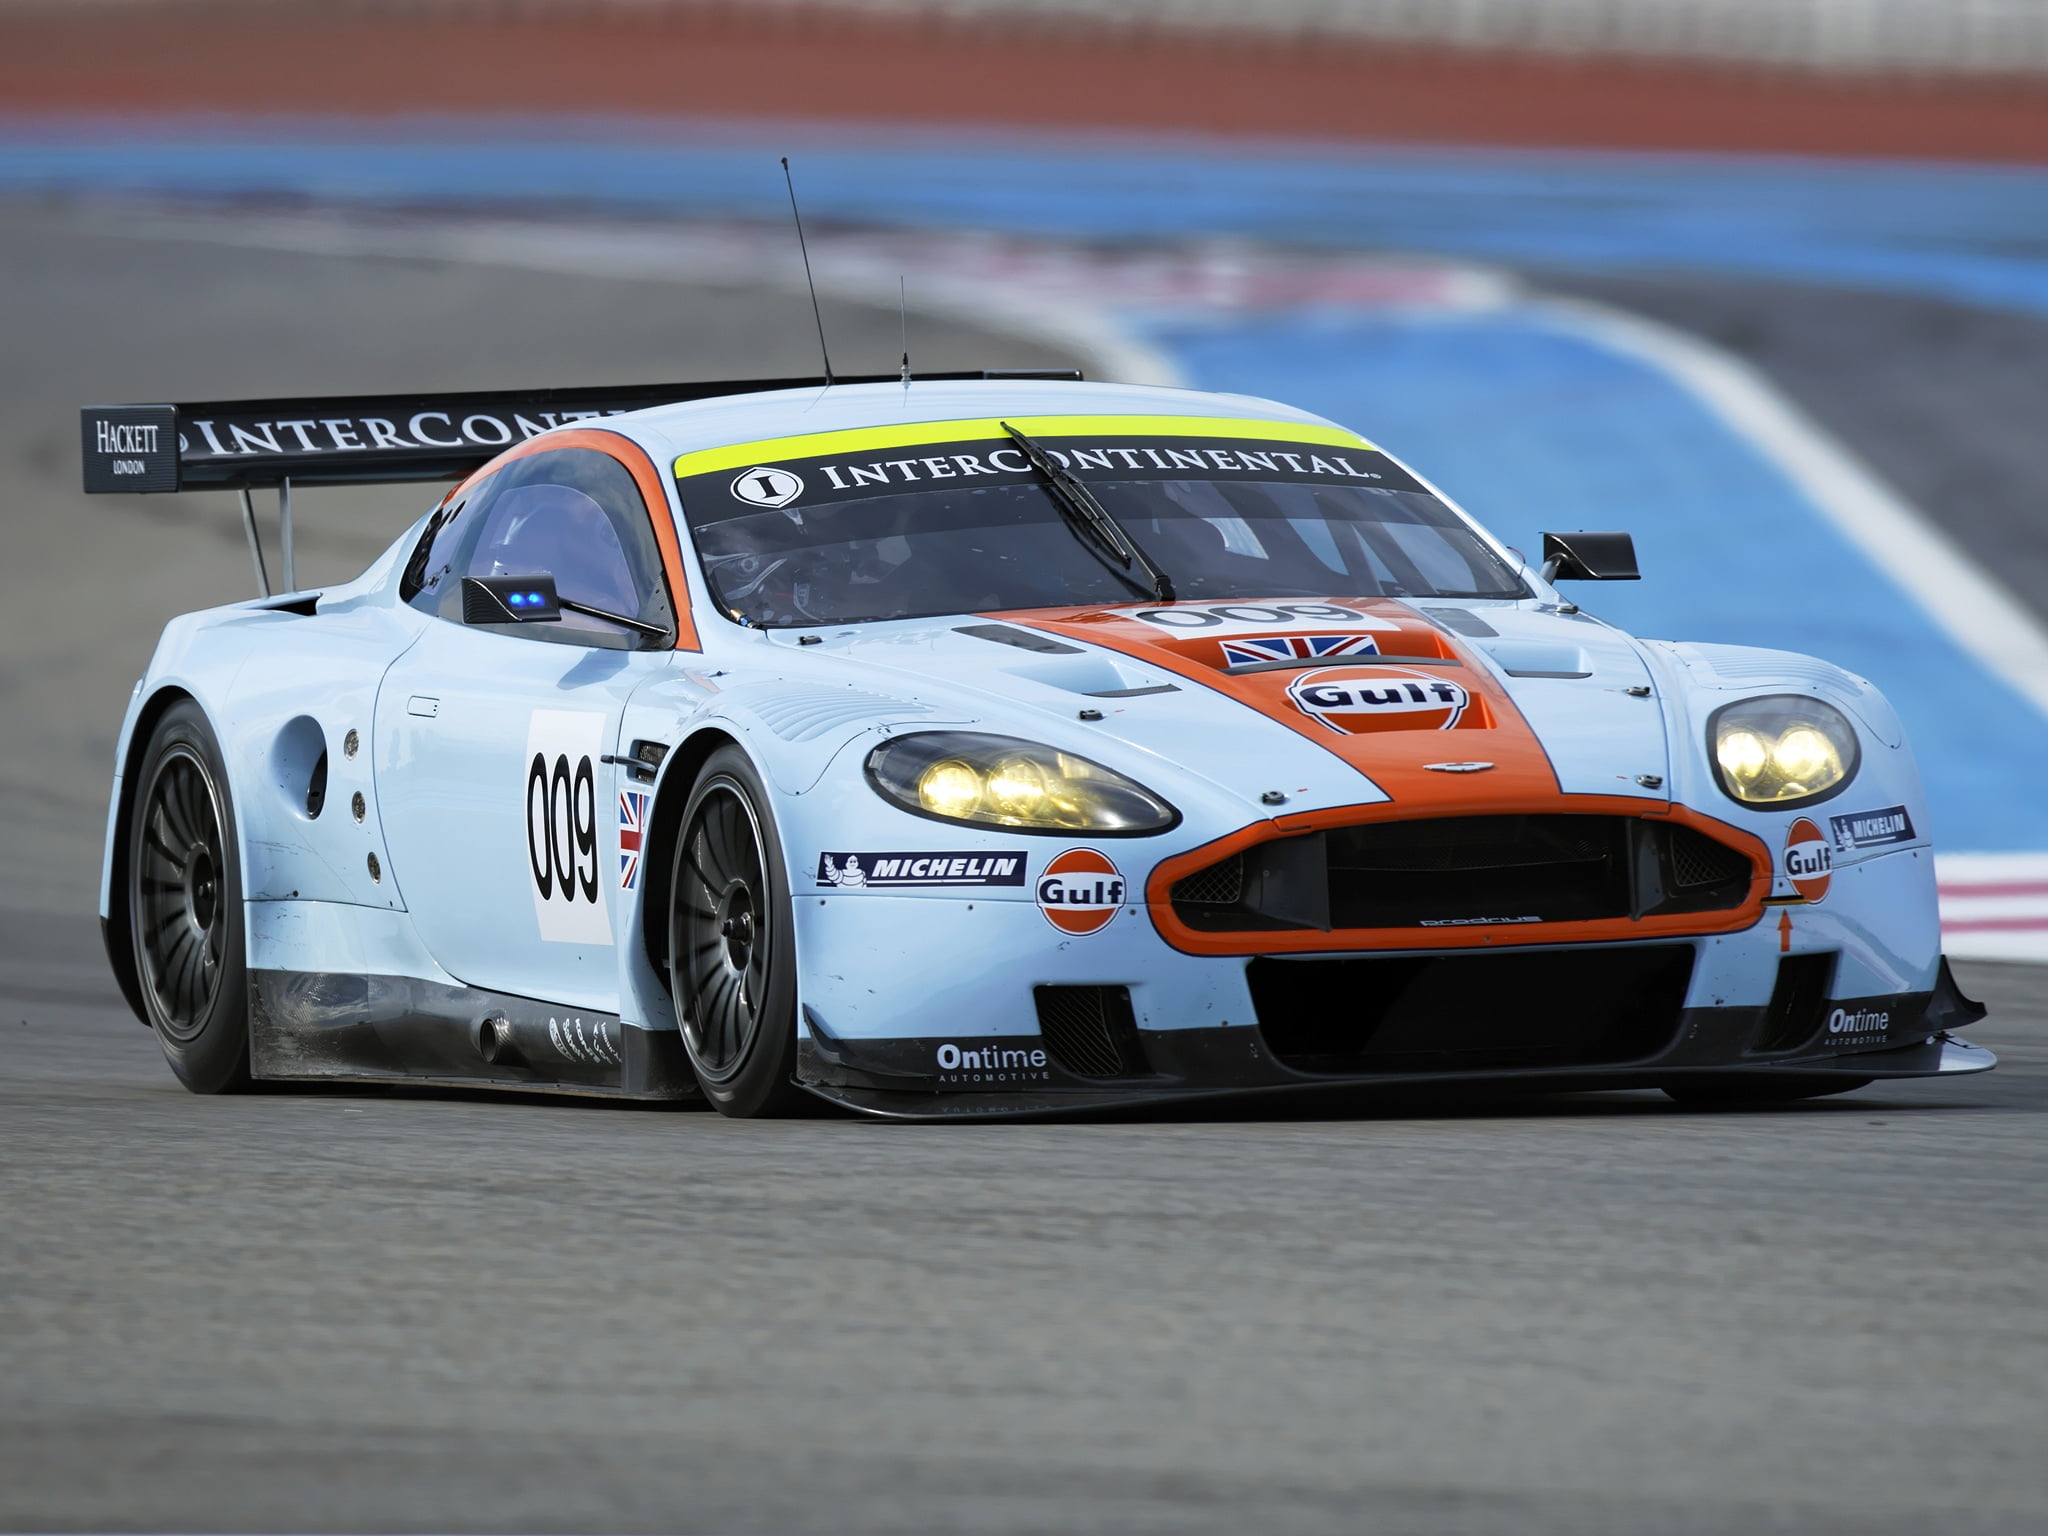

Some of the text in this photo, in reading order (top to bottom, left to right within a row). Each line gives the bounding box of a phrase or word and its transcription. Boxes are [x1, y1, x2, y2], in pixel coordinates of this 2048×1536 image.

[96, 420, 159, 453] HACKETT
[113, 460, 145, 475] LONDON
[1135, 605, 1364, 628] 009
[1299, 682, 1457, 708] Gulf
[527, 752, 599, 905] 009
[1852, 813, 1906, 839] MICHELIN
[872, 858, 1018, 877] MICHELIN
[1786, 850, 1831, 875] Gulf
[1039, 878, 1123, 904] Gulf
[1829, 1008, 1889, 1033] Ontime
[1824, 1035, 1888, 1046] AUTOMOTIVE
[937, 1043, 1048, 1070] Ontime
[939, 1072, 1050, 1083] AUTOMOTIVE
